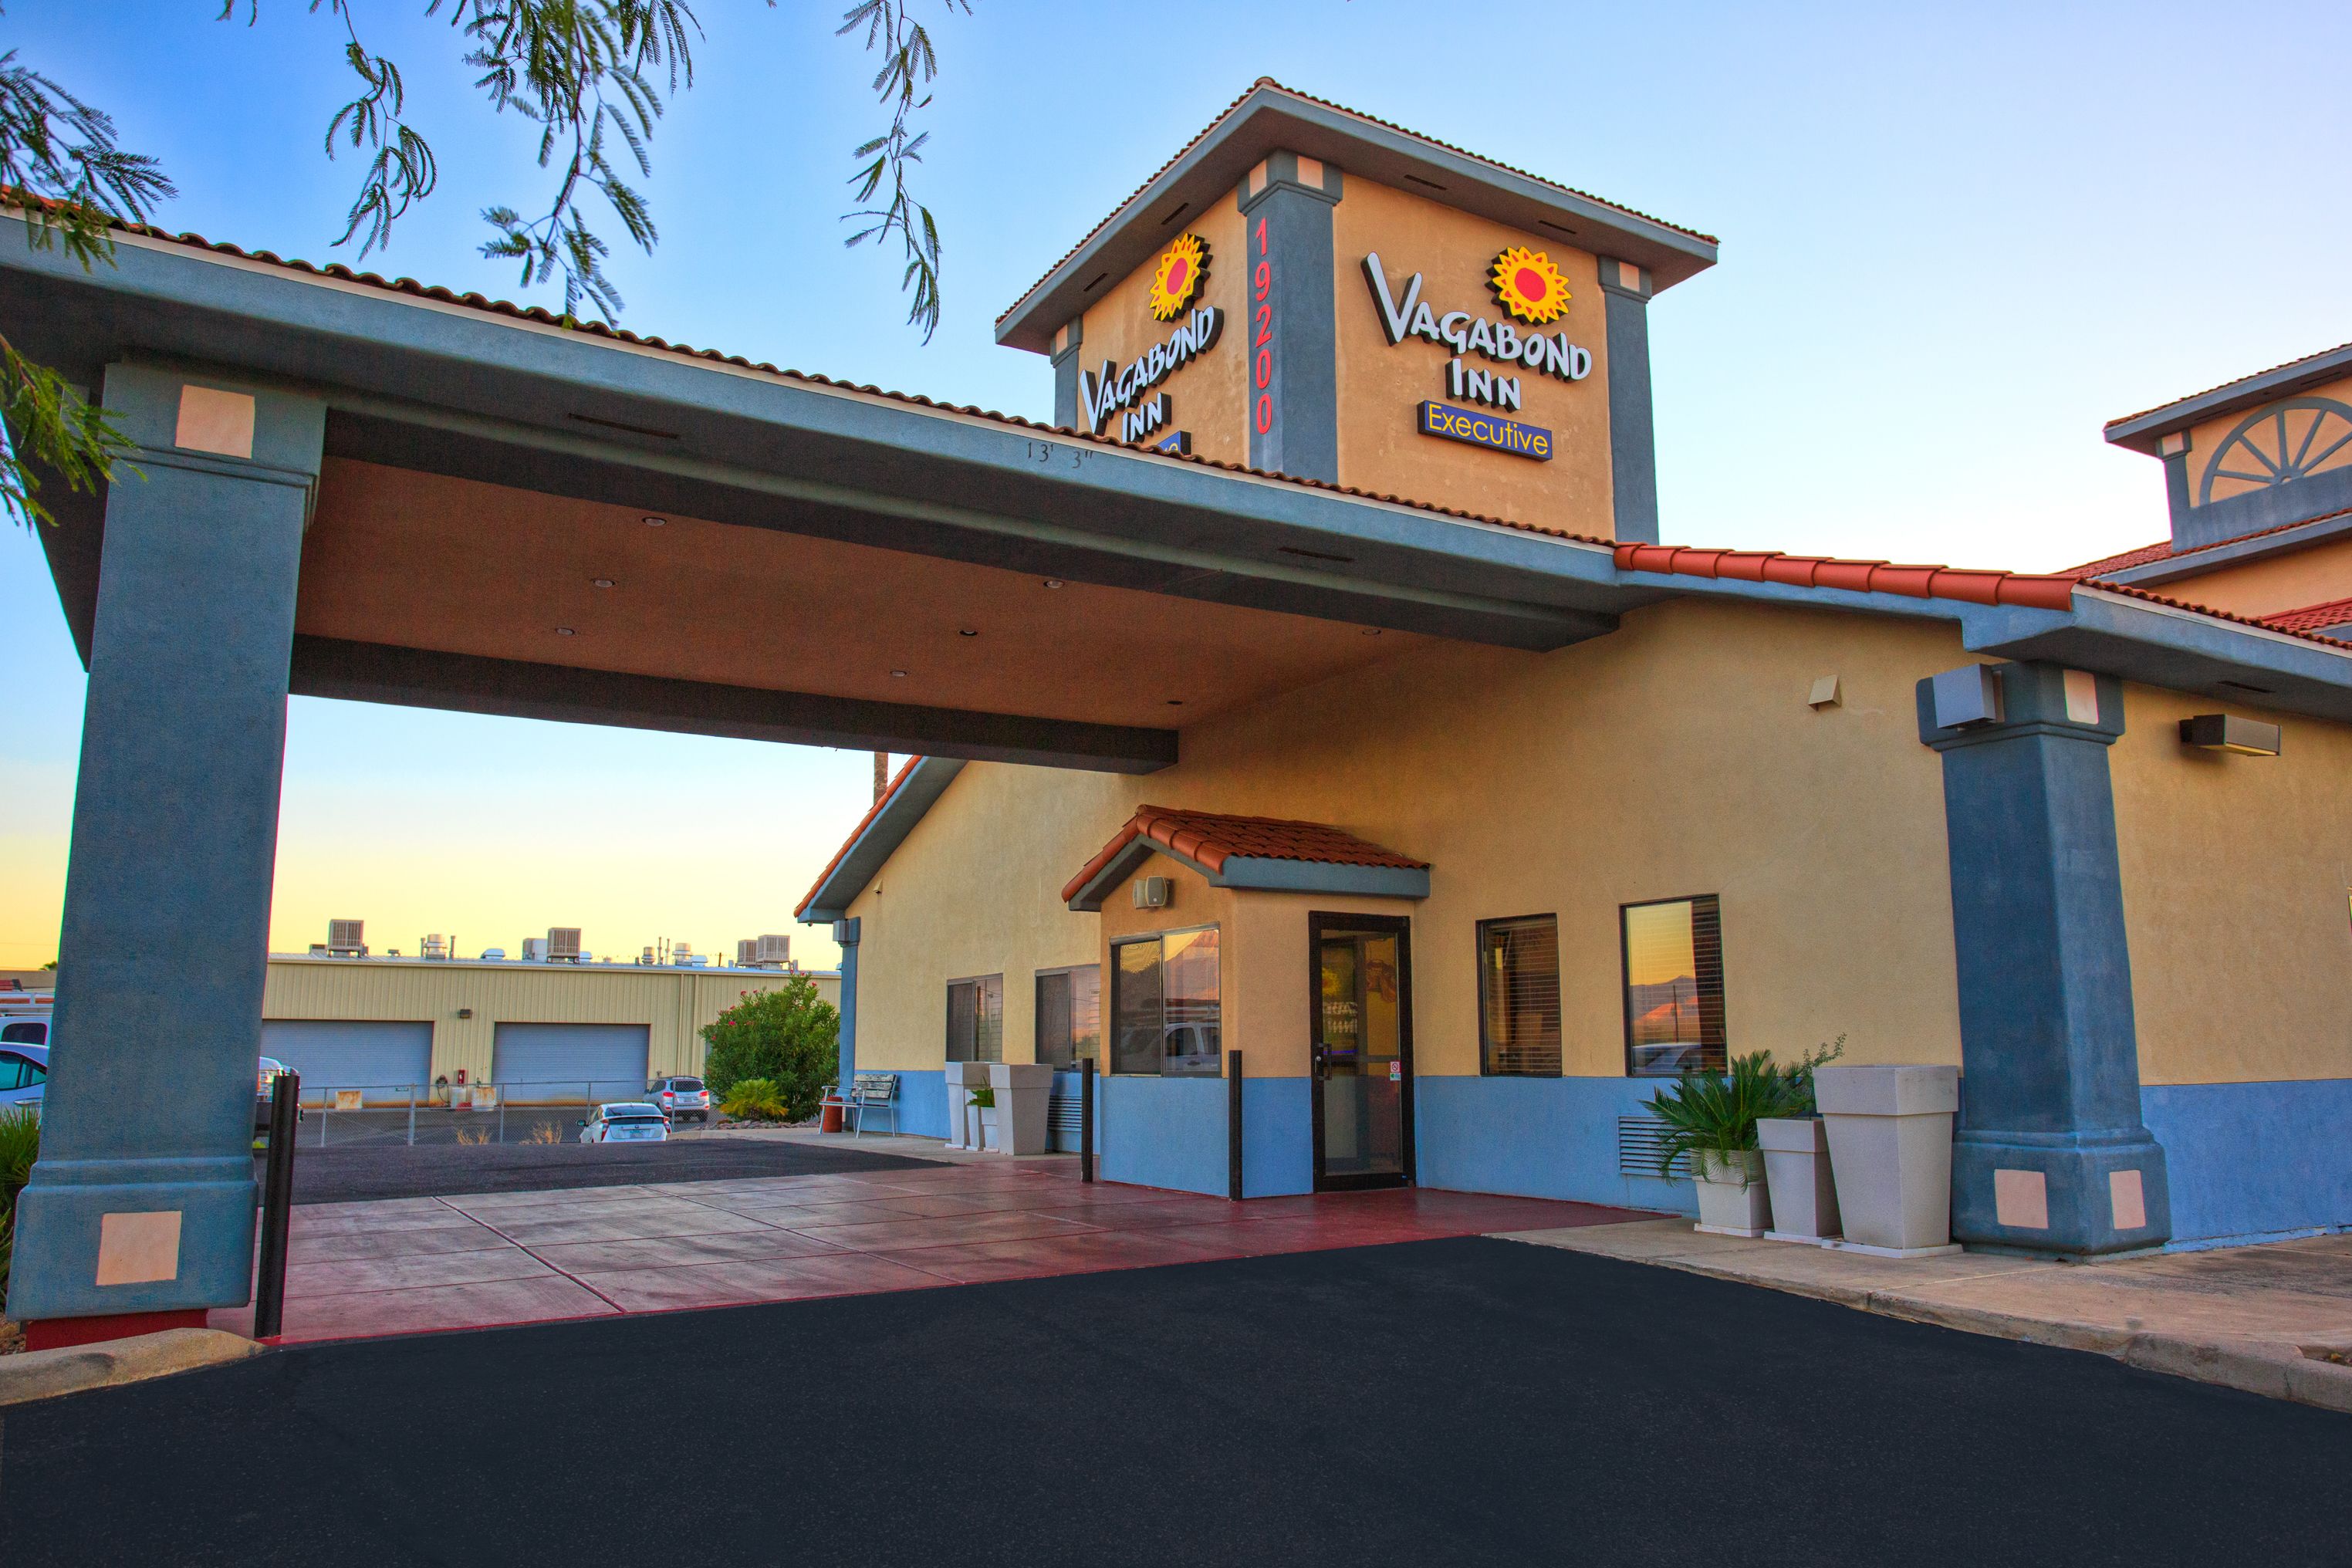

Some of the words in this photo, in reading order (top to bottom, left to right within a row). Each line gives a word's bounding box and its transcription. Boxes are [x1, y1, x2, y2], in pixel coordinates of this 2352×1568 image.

[1255, 217, 1272, 434] 19200
[1367, 252, 1592, 380] VAGABOND
[1080, 306, 1215, 434] VAGABOND
[1451, 358, 1520, 410] INN
[1121, 392, 1161, 443] INN
[1428, 403, 1549, 455] Executive
